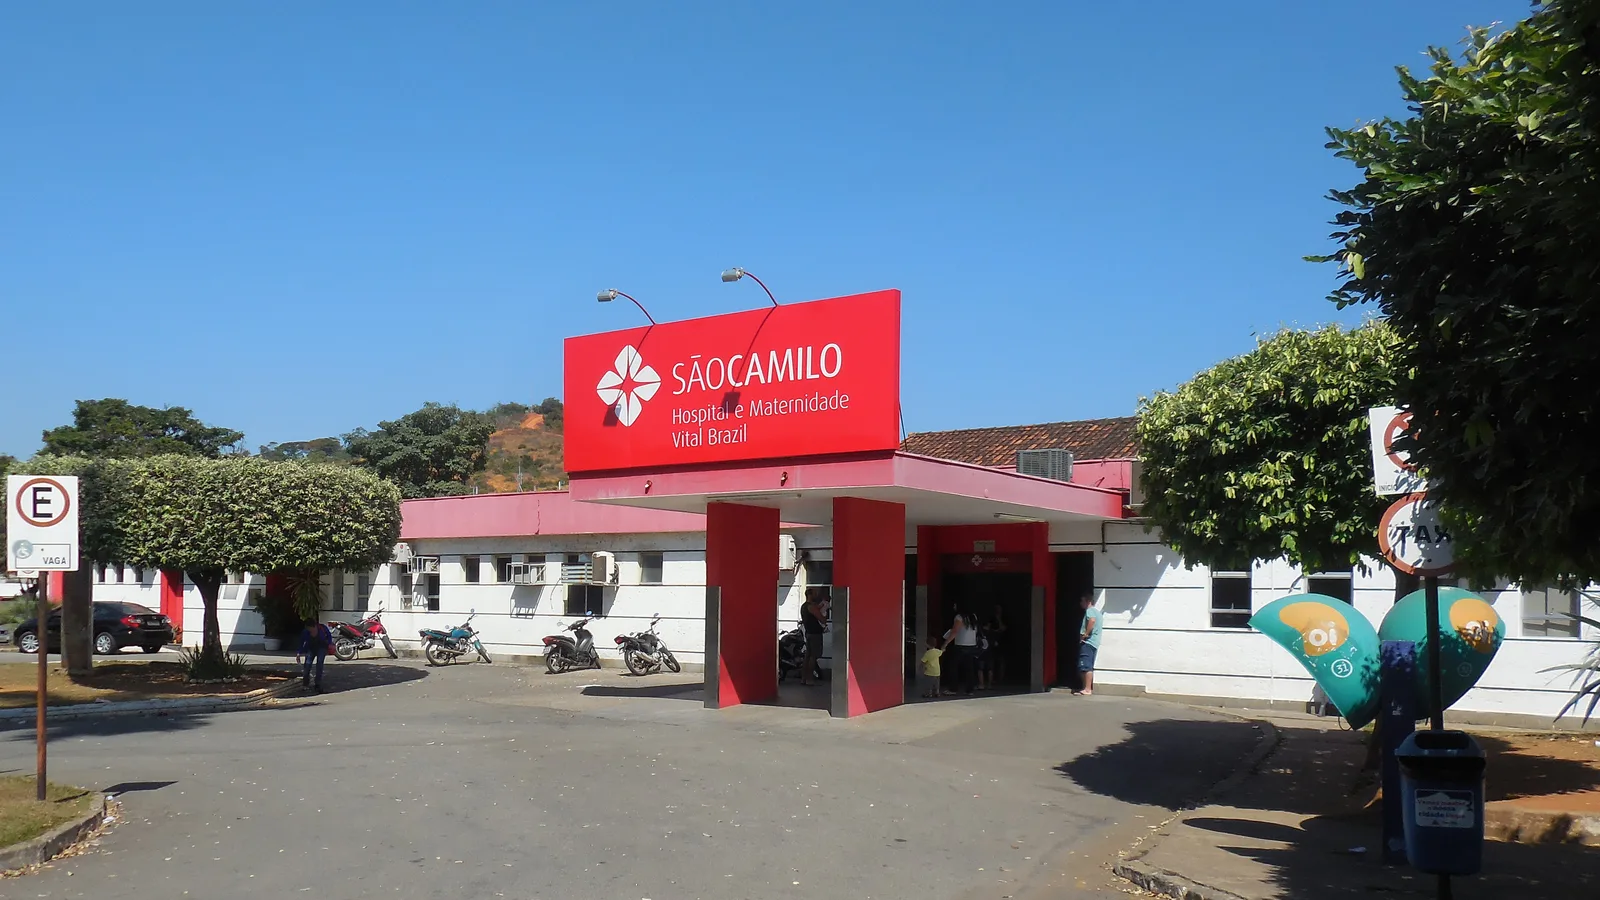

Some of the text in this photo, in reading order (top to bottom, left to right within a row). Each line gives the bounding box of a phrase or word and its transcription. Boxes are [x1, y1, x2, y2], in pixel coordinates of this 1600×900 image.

[672, 343, 842, 395] SÃOCAMILO
[672, 390, 849, 426] Hospital e Maternidade
[672, 424, 747, 448] Vital Brazil
[32, 487, 53, 518] E
[1309, 621, 1337, 647] oi
[1336, 661, 1349, 674] 31
